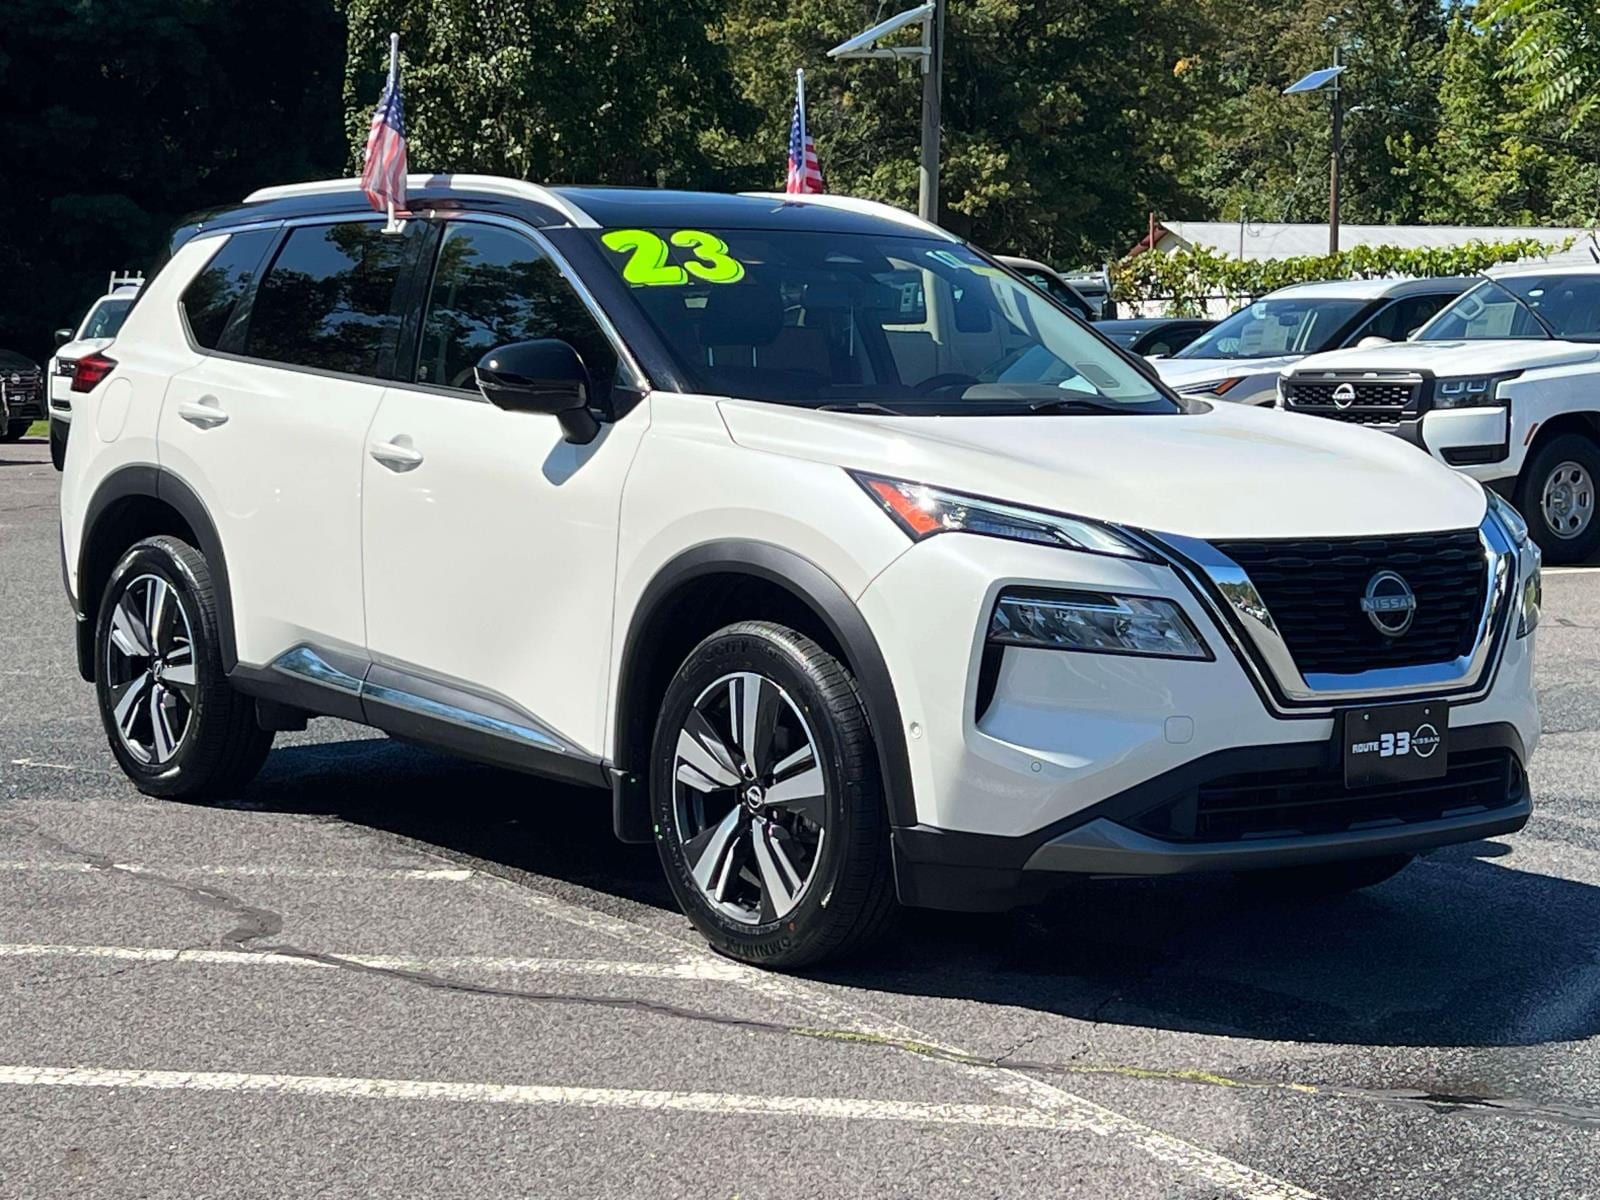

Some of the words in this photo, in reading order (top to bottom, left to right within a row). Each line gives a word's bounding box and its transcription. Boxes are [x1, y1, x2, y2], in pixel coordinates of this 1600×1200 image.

[601, 229, 745, 286] 23
[1362, 597, 1415, 610] NISSAN
[1352, 741, 1379, 754] ROUTE
[1380, 731, 1410, 757] 33
[1411, 736, 1440, 745] NISSAN
